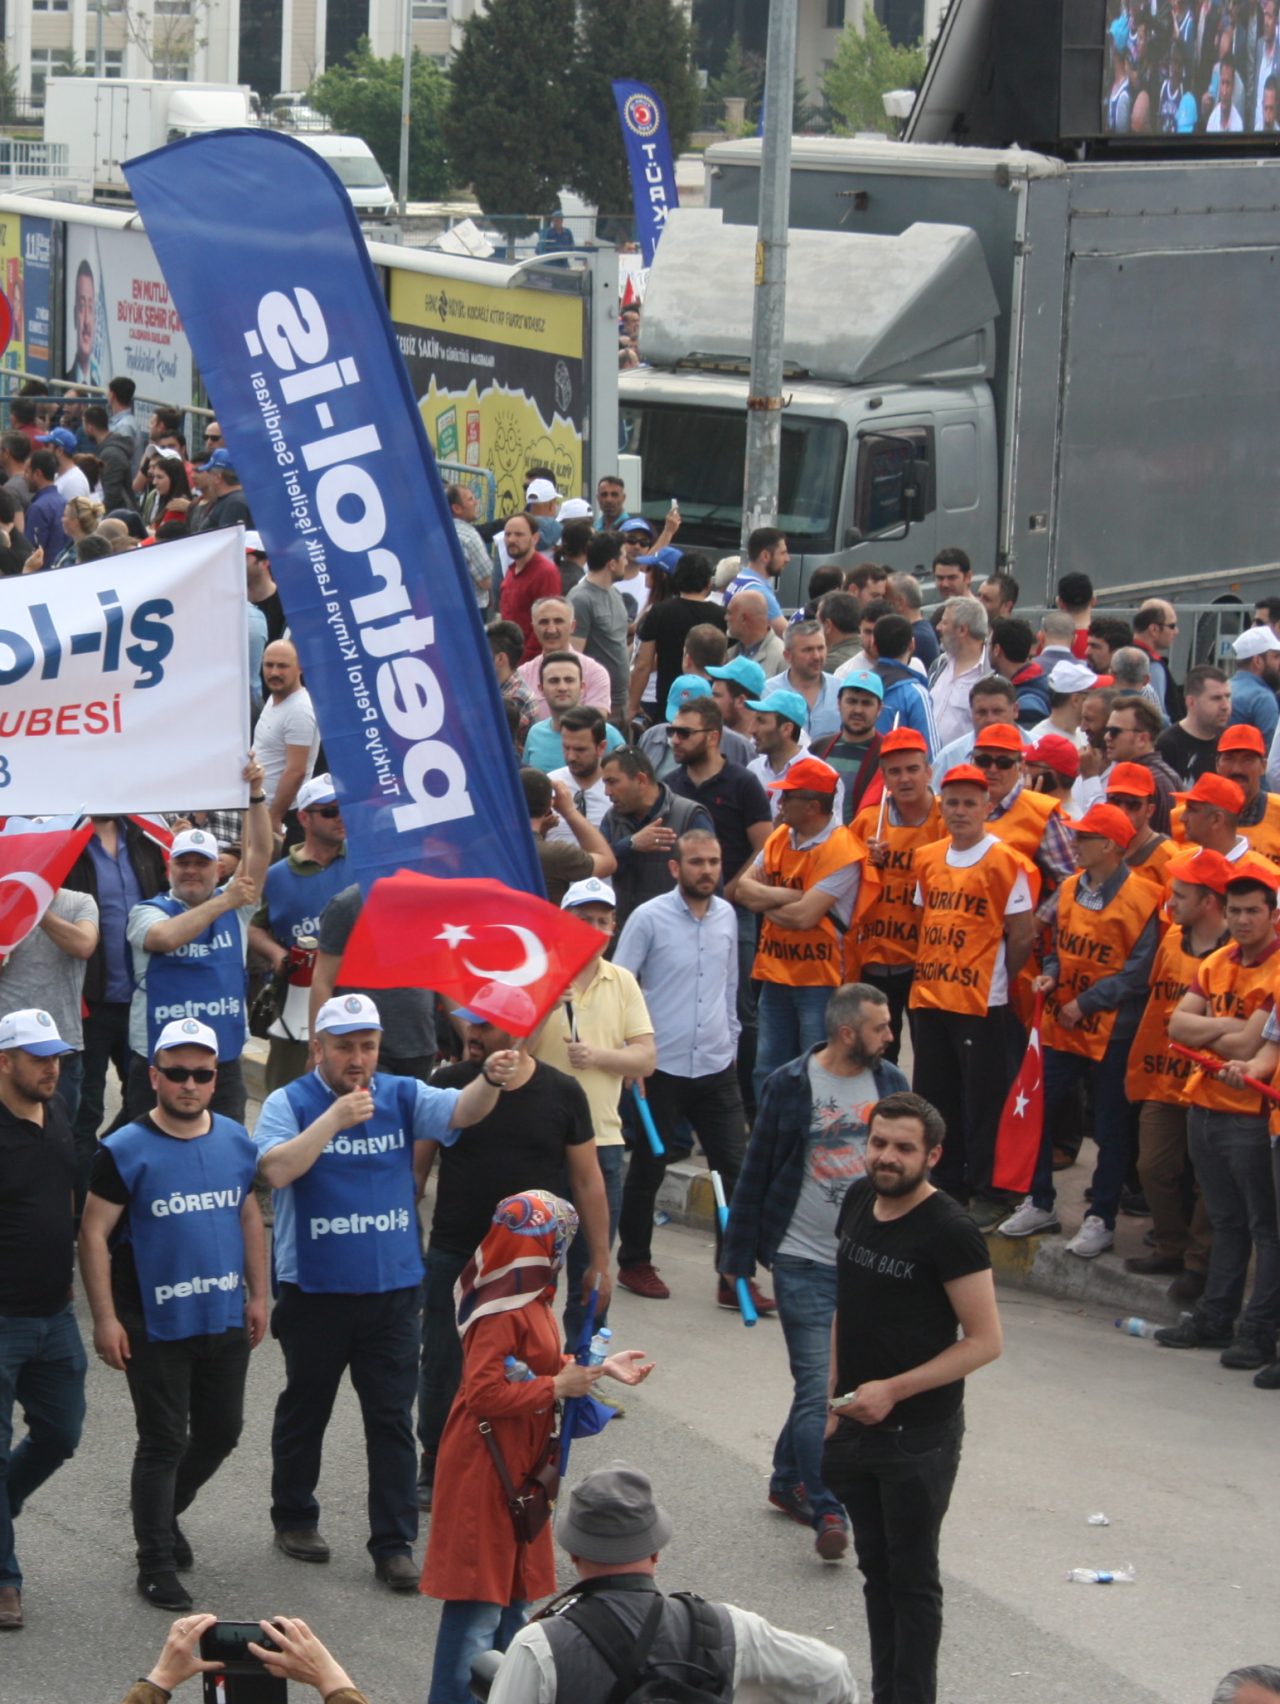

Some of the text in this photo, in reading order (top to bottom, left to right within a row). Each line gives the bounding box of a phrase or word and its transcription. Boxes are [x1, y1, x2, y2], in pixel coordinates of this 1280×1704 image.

[396, 333, 416, 356] ESSİZ
[154, 997, 240, 1025] petrol-iş
[152, 1186, 241, 1217] GÖREVLİ
[310, 1208, 409, 1240] petrol-iş
[876, 1254, 915, 1280] BACK
